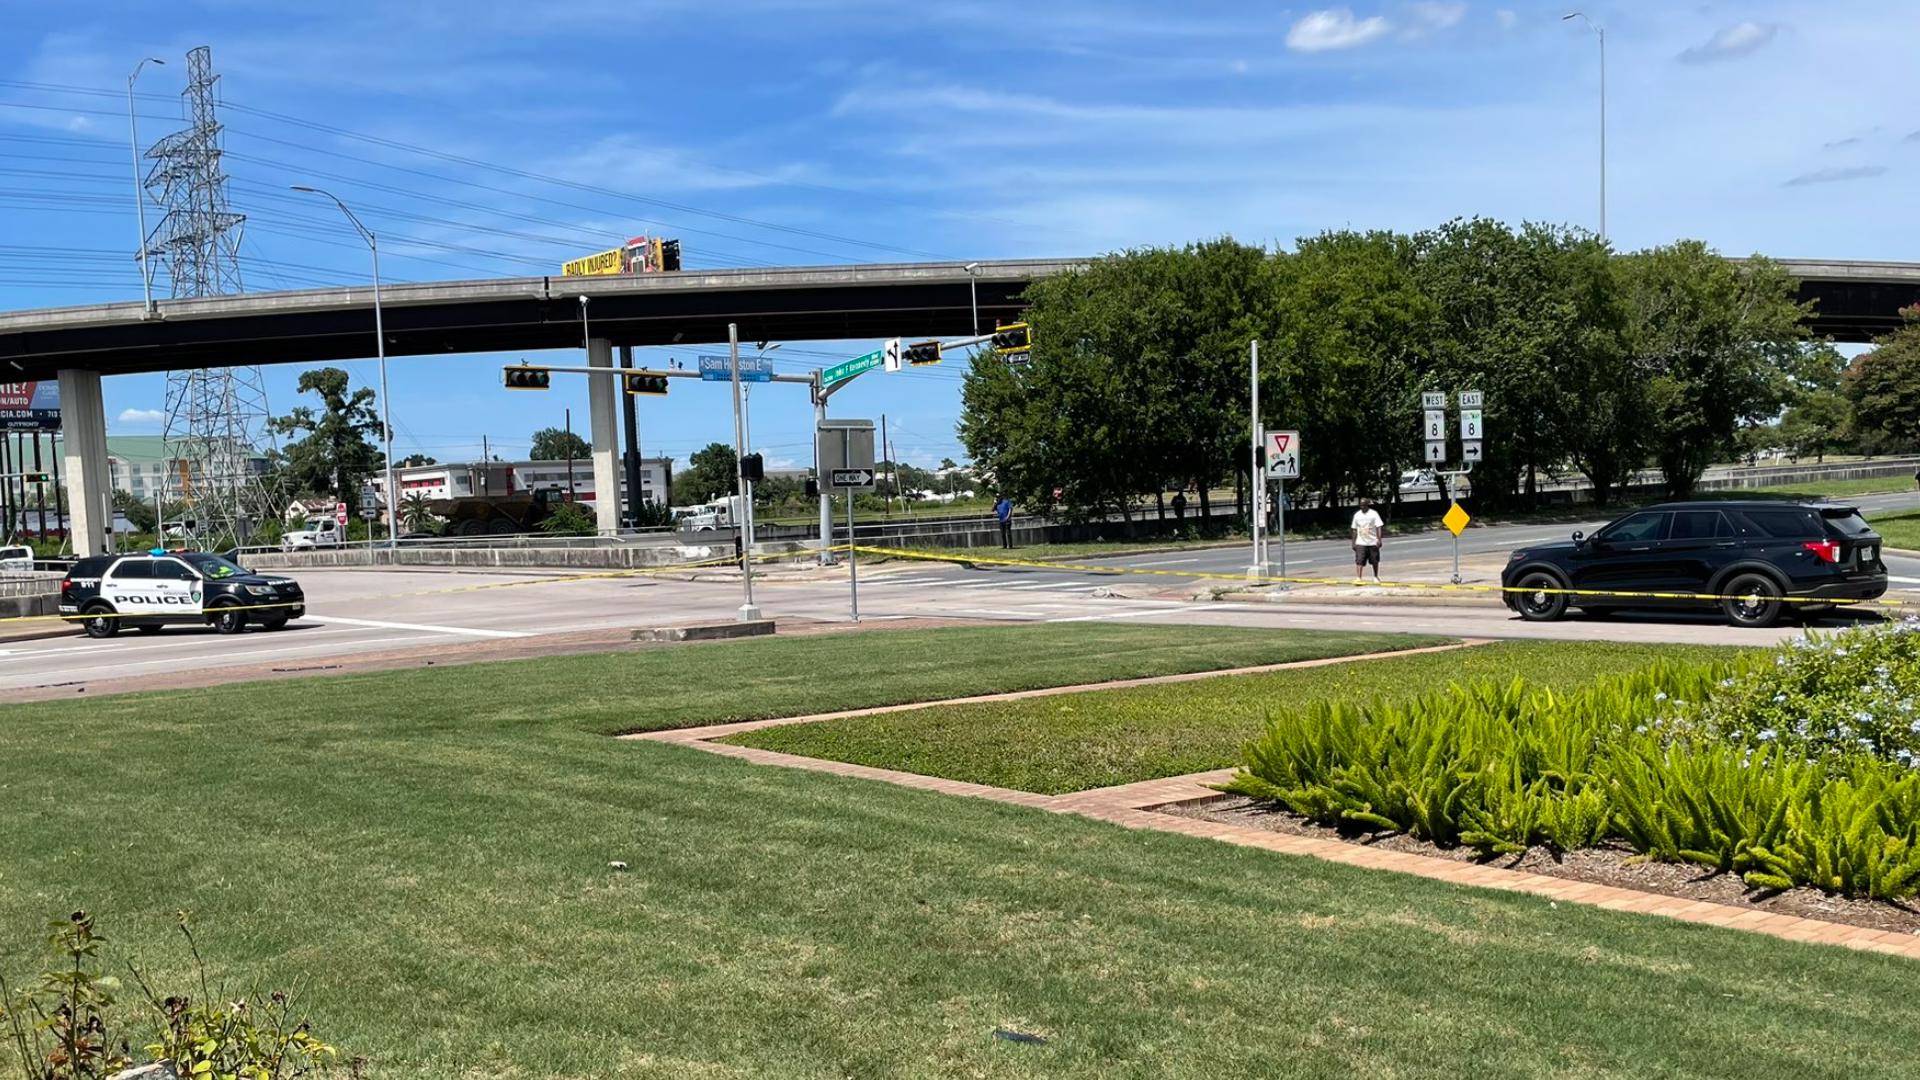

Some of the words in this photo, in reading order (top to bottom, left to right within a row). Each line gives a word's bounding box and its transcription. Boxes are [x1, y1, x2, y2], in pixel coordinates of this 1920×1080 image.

[565, 260, 586, 277] BADLY
[587, 251, 617, 274] INJURED?
[704, 357, 723, 370] Sam
[723, 358, 756, 371] Hston
[756, 359, 762, 371] E
[1425, 395, 1443, 405] WEST
[1462, 394, 1479, 405] EAST
[1432, 423, 1438, 436] 8
[1468, 422, 1475, 436] 8
[836, 473, 847, 481] ONE
[849, 473, 860, 481] WAY
[114, 595, 192, 604] POLICE
